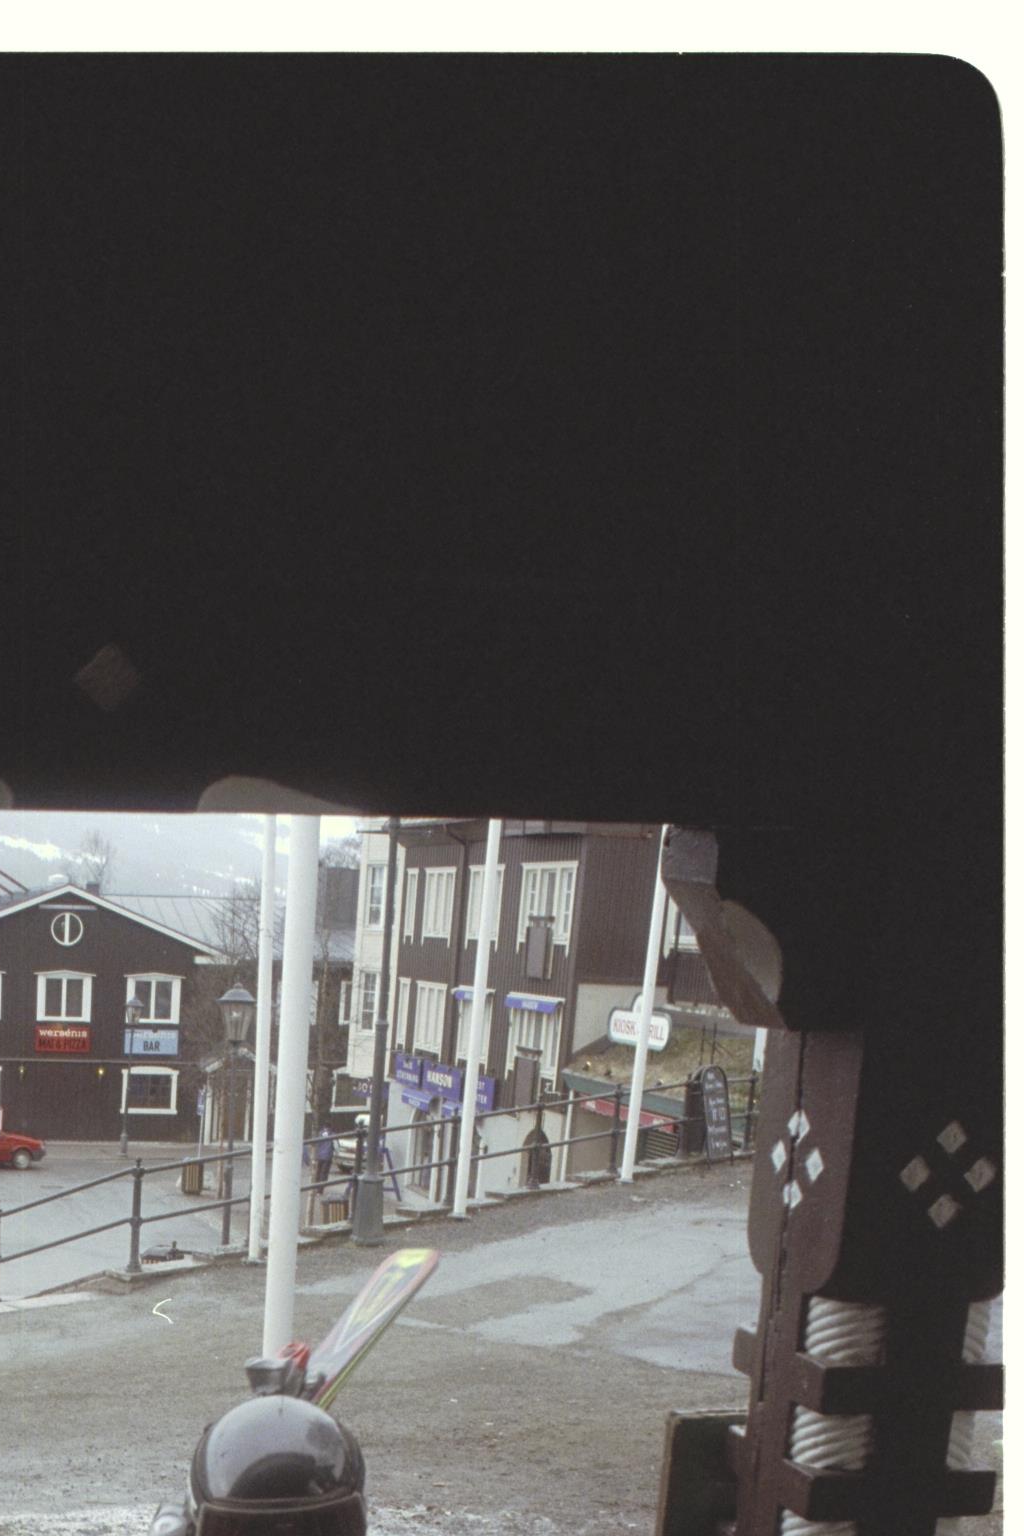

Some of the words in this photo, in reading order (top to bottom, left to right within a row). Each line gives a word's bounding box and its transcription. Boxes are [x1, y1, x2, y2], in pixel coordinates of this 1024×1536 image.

[612, 1019, 636, 1036] KIOSK
[647, 1024, 665, 1041] RILL
[142, 1040, 161, 1053] BAR
